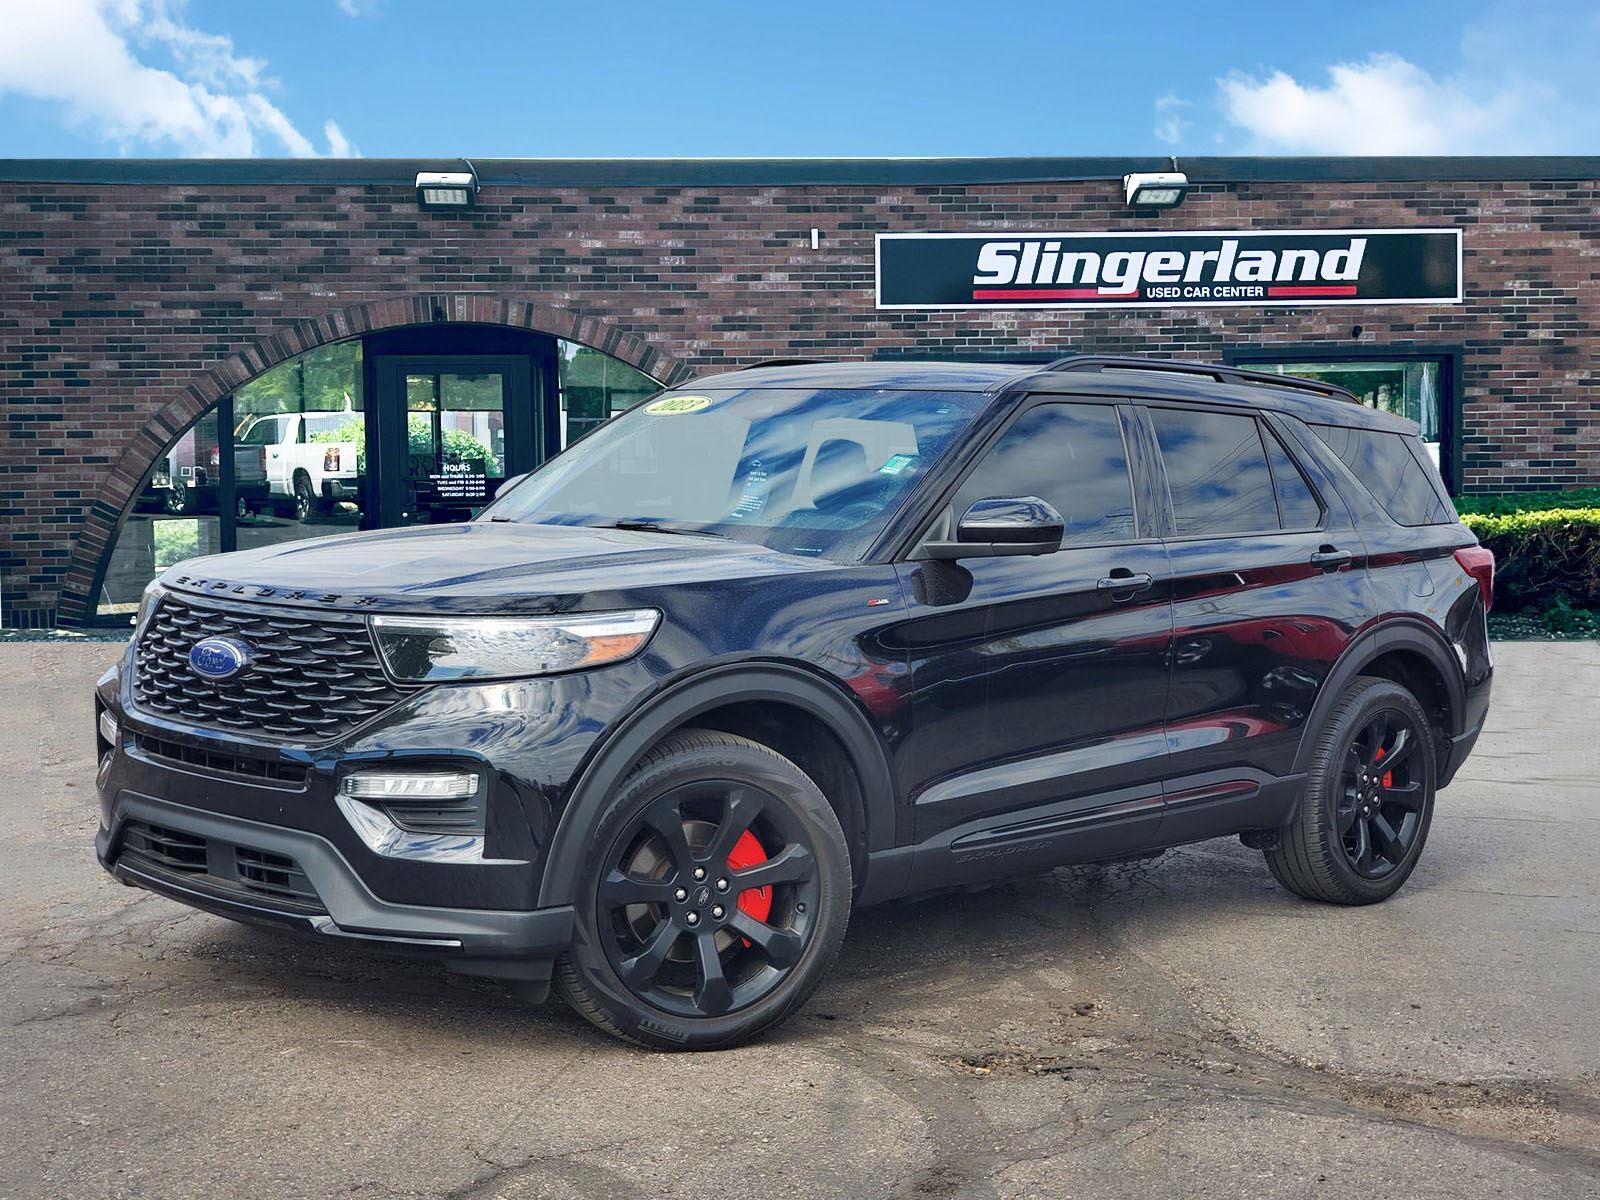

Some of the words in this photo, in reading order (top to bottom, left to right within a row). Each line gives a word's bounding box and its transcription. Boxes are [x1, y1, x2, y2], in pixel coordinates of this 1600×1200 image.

[973, 239, 1368, 295] Slingerland
[1146, 287, 1180, 299] USED
[1183, 287, 1210, 298] CAR
[1213, 286, 1264, 298] CENTER
[442, 464, 471, 472] HOURS
[175, 576, 381, 606] EXPLORER
[196, 647, 228, 669] Ford
